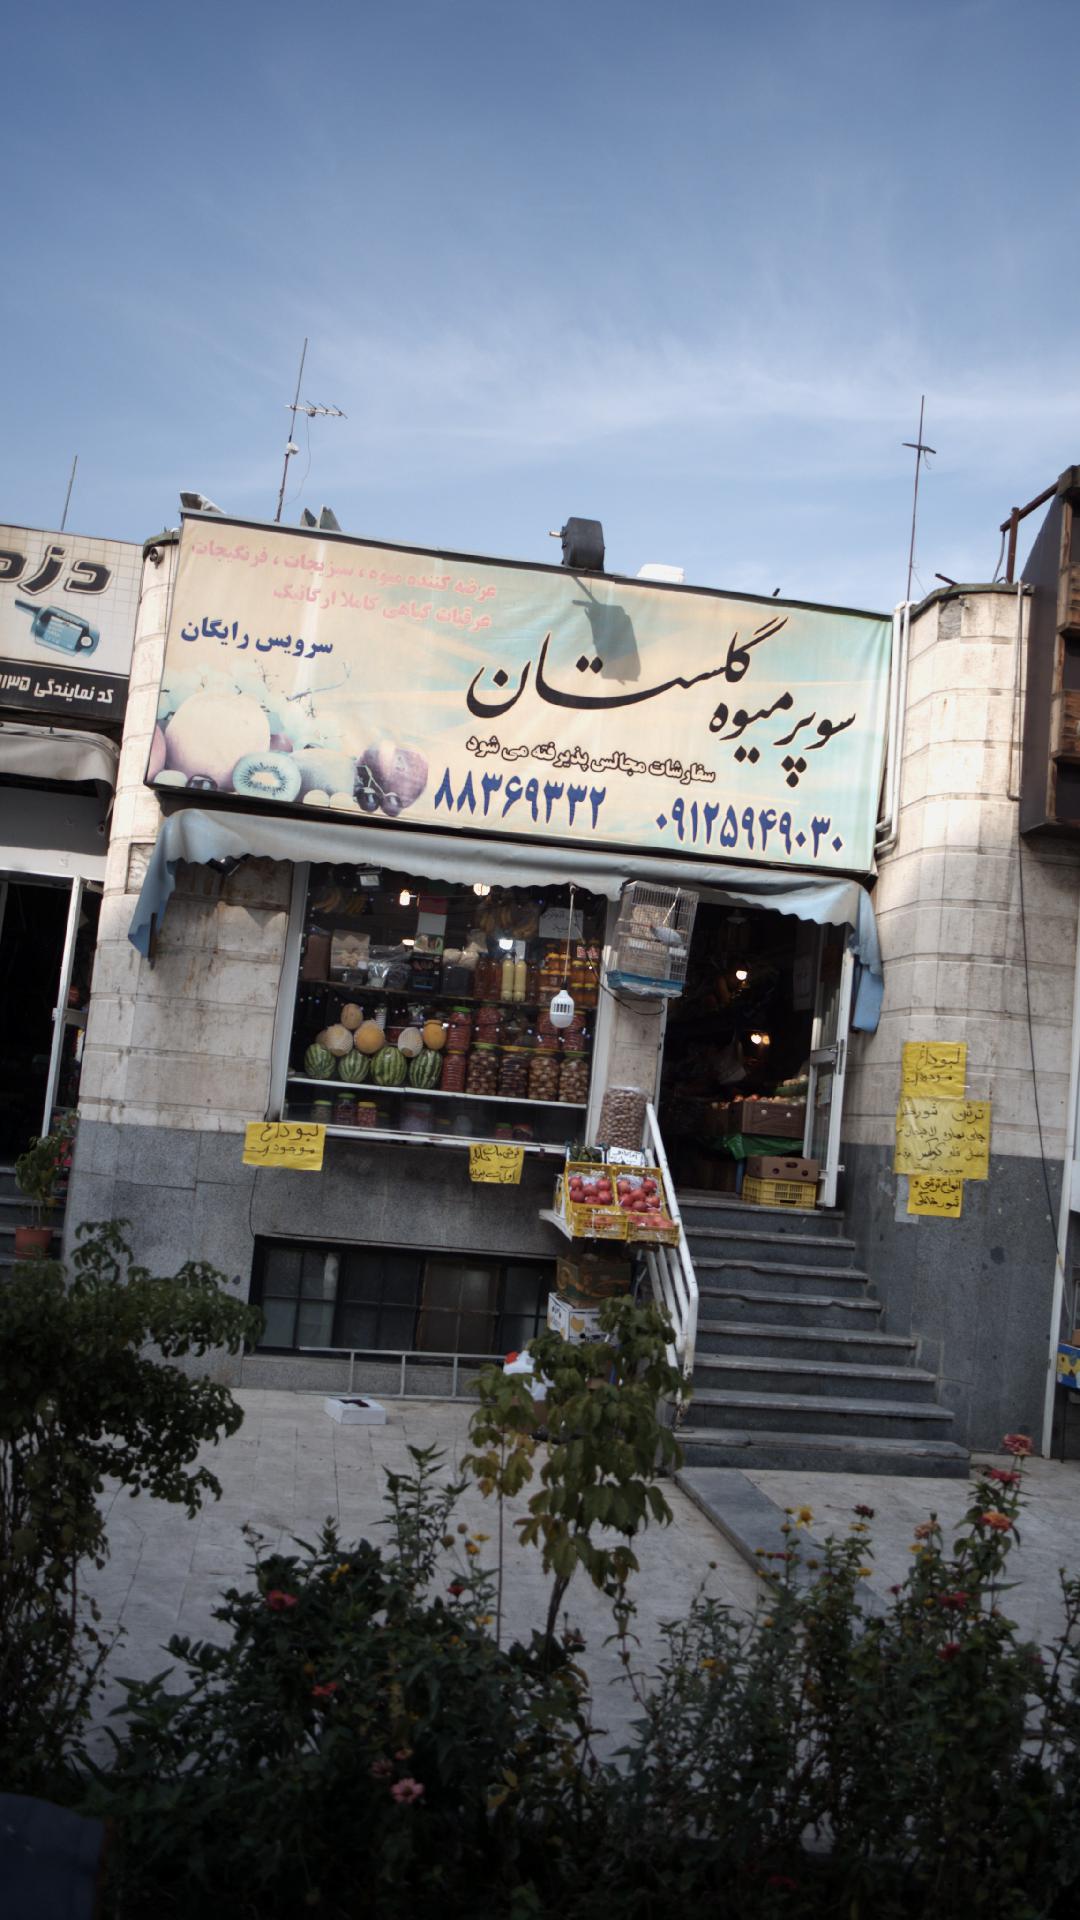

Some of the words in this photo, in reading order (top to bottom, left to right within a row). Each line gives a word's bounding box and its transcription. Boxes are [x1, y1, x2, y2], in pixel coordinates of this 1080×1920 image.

[407, 574, 451, 591] کننده
[453, 578, 498, 603] عرضه
[382, 601, 433, 623] گیاهی
[434, 606, 493, 633] عرقیات
[180, 616, 250, 650] رایگان
[255, 633, 334, 659] سرویس
[465, 616, 790, 719] گلستان
[33, 678, 96, 702] نمایندگی
[96, 688, 114, 704] کد
[708, 690, 795, 765] میوه
[465, 734, 501, 758] شود
[501, 745, 530, 762] می
[530, 741, 590, 773] پذیرفته
[772, 711, 857, 788] سوپر
[590, 750, 647, 777] مجالس
[648, 758, 716, 785] سفارشات
[434, 767, 607, 830] ۸۸۳۶۹۳۳۲
[655, 797, 844, 859] ۰۹۱۲۵۹۴۹۰۳۰
